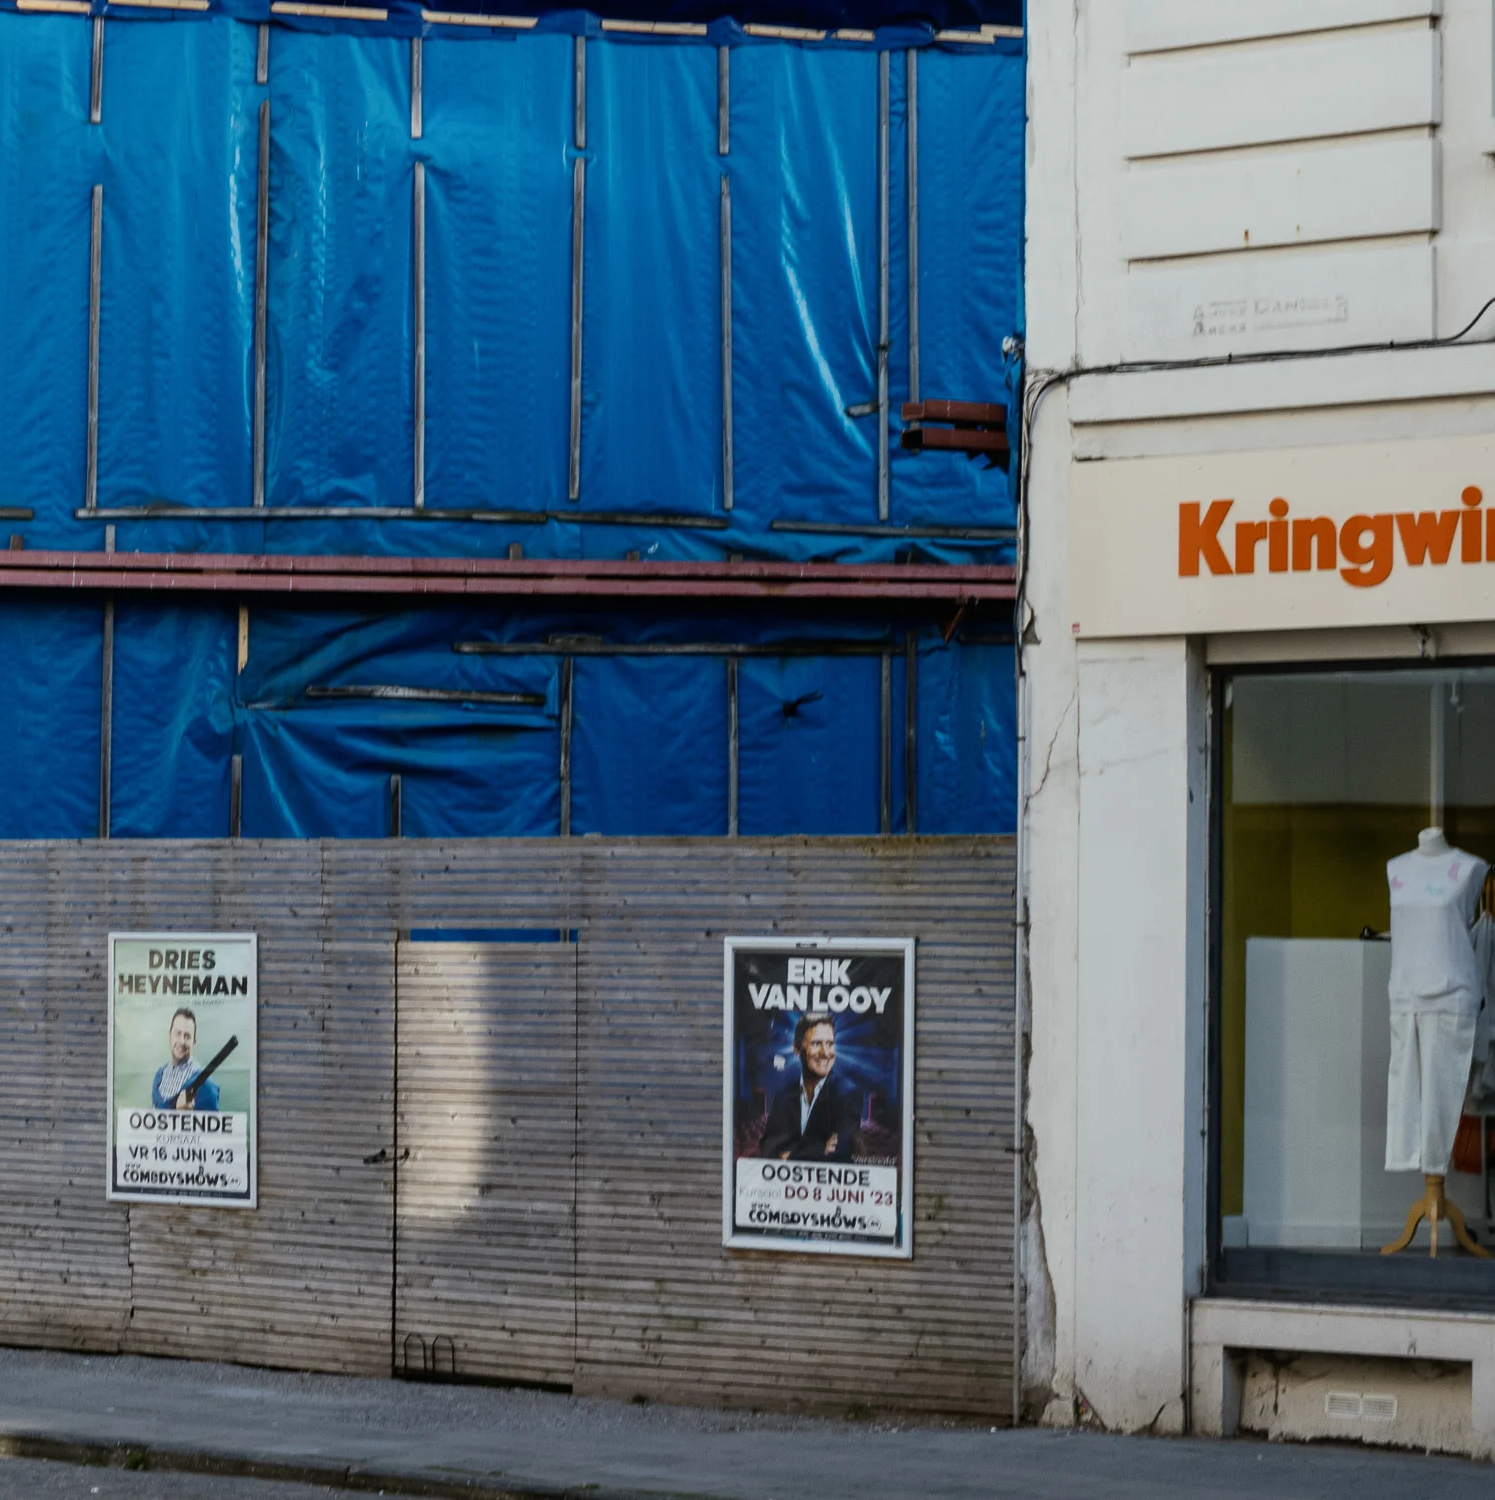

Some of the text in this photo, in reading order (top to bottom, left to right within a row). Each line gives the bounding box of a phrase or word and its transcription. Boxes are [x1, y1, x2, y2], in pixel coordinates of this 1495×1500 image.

[1178, 485, 1495, 588] Kringwi
[149, 949, 216, 970] DRIES
[787, 957, 852, 986] ERIK
[118, 973, 248, 997] HEYNEMAN
[748, 983, 892, 1014] VAN LOOY
[129, 1112, 233, 1133] OOSTENDE
[129, 1144, 148, 1160] VR
[152, 1146, 167, 1161] 16
[172, 1147, 207, 1163] JUNI
[761, 1164, 870, 1187] OOSTENDE
[784, 1185, 808, 1200] DO
[812, 1187, 822, 1201] 8
[826, 1188, 865, 1205] JUNI
